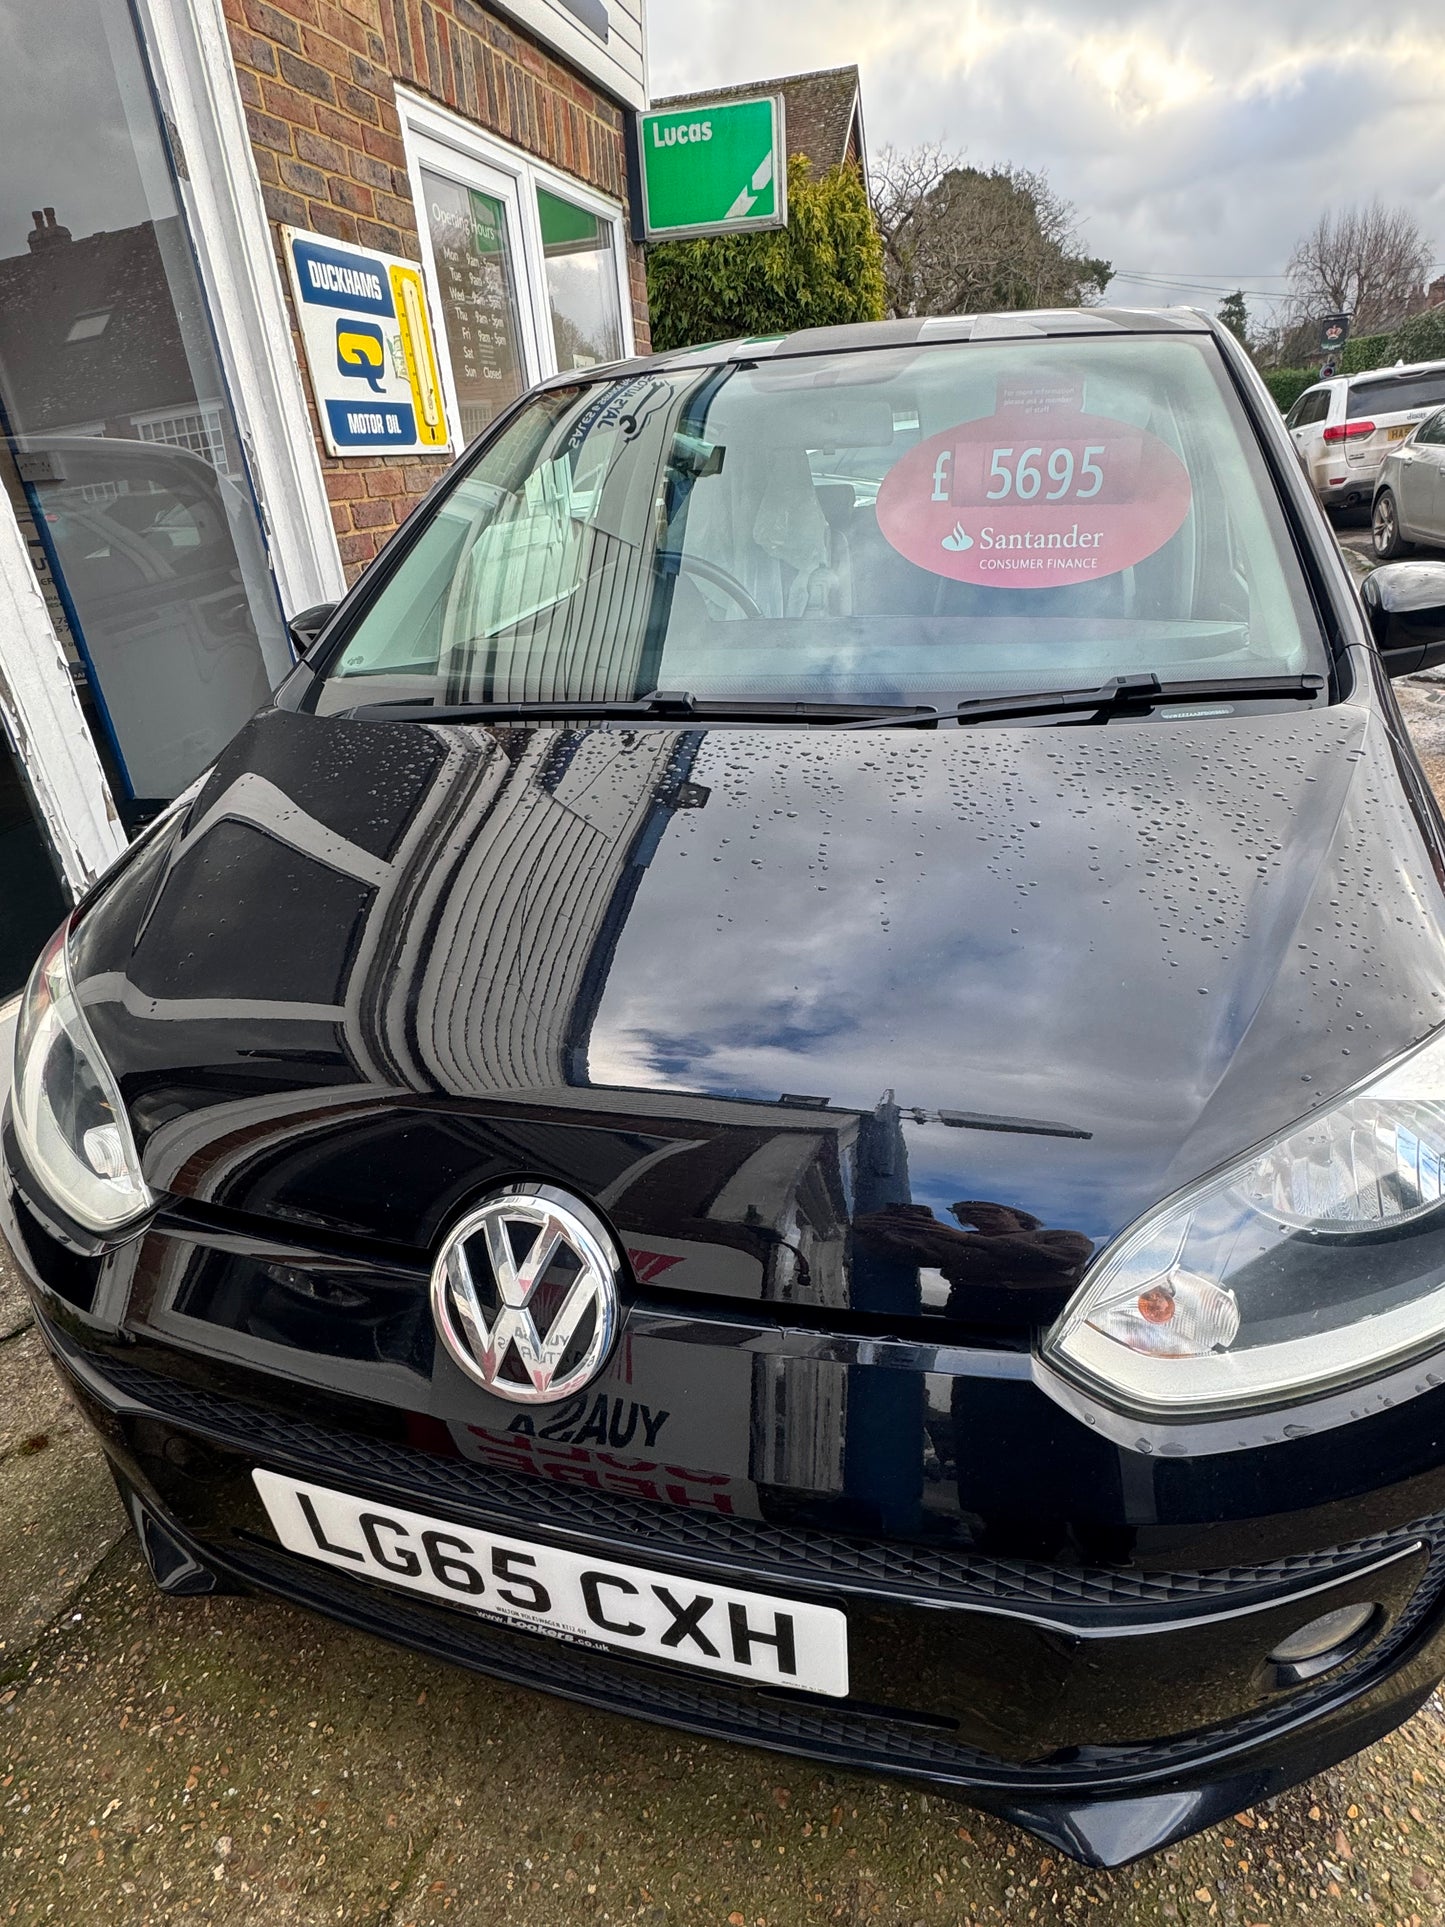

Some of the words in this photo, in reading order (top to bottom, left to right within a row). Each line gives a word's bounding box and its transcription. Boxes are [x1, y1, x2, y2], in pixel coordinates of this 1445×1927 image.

[652, 121, 713, 148] Lucas
[432, 203, 471, 236] Opening
[469, 219, 496, 241] Hours
[307, 260, 382, 301] DUCKHAMS
[483, 366, 502, 380] Closed
[347, 413, 384, 434] MOTOR
[386, 412, 402, 434] OIL
[931, 451, 951, 501] £
[986, 446, 1106, 500] 5695
[979, 524, 1104, 551] Santander
[979, 558, 1044, 570] CONSUMER
[1047, 558, 1098, 569] FINANCE
[295, 1491, 552, 1614] LG65
[580, 1571, 798, 1676] CXH
[476, 1610, 611, 1652] www.Lookers.co.uk
[521, 1611, 562, 1629] VOLKSWAGEN
